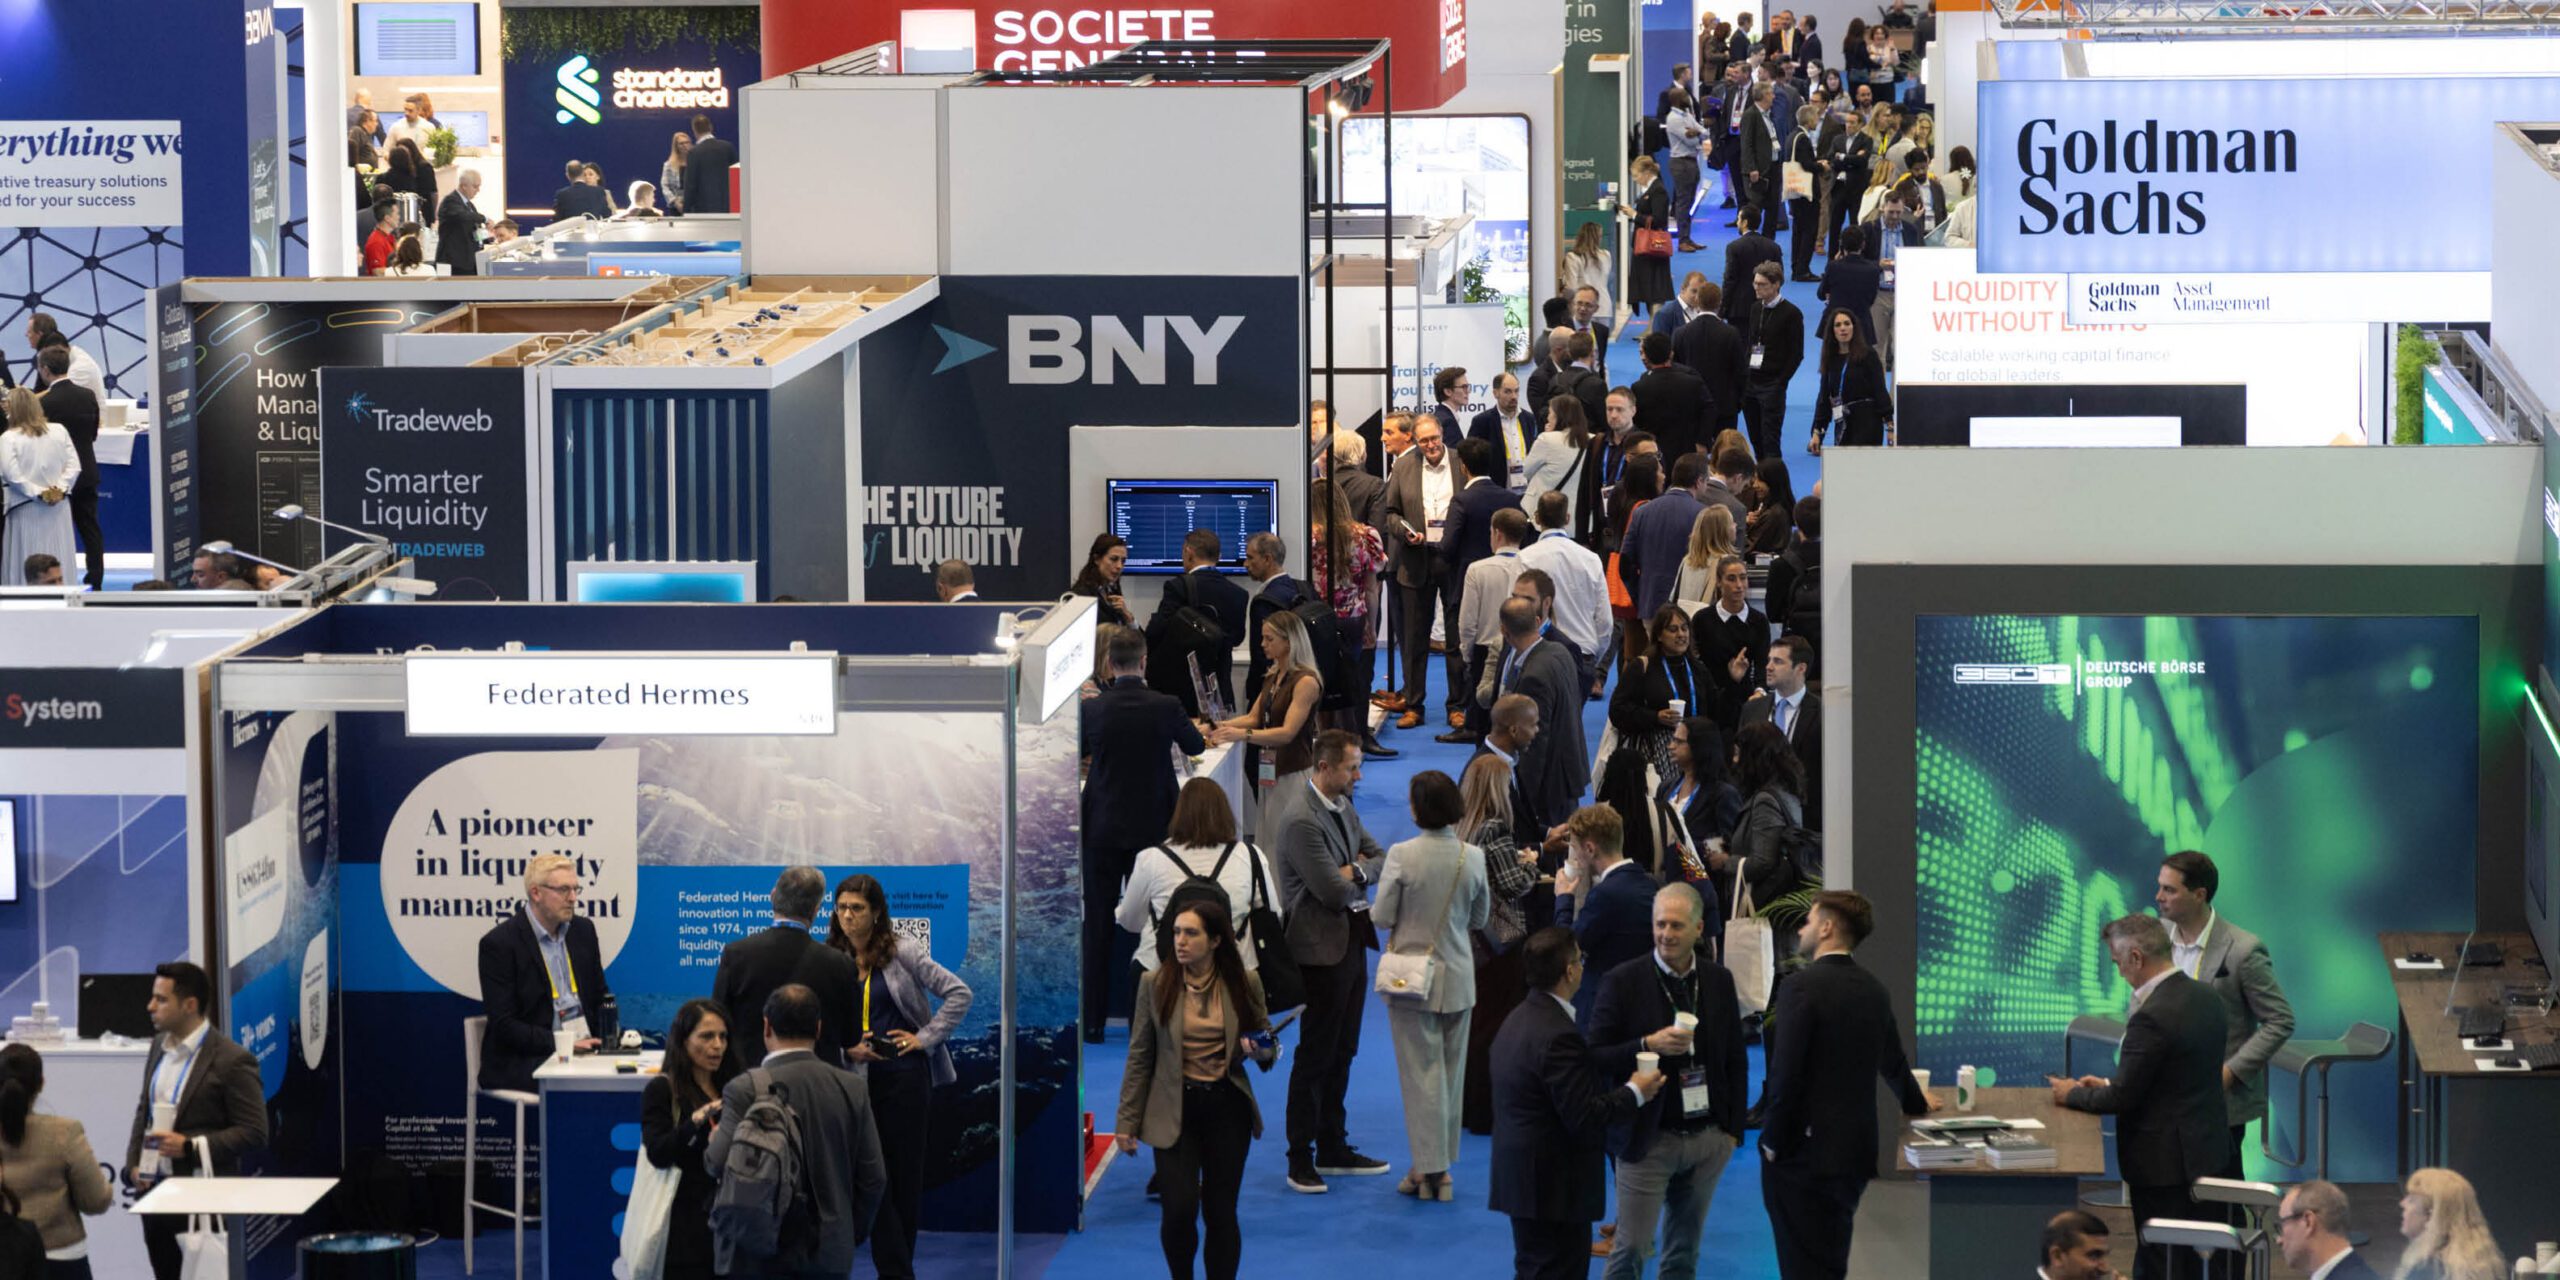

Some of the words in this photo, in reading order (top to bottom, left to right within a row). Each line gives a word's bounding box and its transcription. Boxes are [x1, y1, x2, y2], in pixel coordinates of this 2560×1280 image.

[245, 7, 274, 45] BBVA
[994, 10, 1215, 44] SOCIETE
[613, 67, 702, 88] standard
[613, 87, 728, 108] chartered
[2017, 118, 2298, 180] Goldman
[34, 175, 96, 191] treasury
[100, 174, 168, 188] solutions
[16, 194, 36, 206] for
[40, 196, 73, 209] your
[77, 196, 136, 206] success
[2018, 180, 2207, 236] Sachs
[1933, 281, 2058, 304] LIQUIDITY
[2088, 282, 2160, 299] Goldman
[2174, 281, 2213, 296] Asset
[2088, 297, 2137, 312] Sachs
[2173, 297, 2271, 313] Management
[1932, 311, 2053, 332] WITHOUT
[1008, 315, 1246, 385] BNY
[1931, 348, 1994, 363] Scalable
[1999, 349, 2057, 366] working
[2062, 348, 2112, 366] capital
[2115, 348, 2170, 362] finance
[257, 369, 306, 388] How
[1931, 368, 1952, 382] for
[1956, 368, 2000, 383] global
[372, 408, 493, 432] Tradeweb
[258, 421, 274, 441] &
[365, 467, 483, 494] Smarter
[362, 498, 488, 531] Liquidity
[901, 486, 1005, 526] FUTURE
[891, 527, 1023, 574] LIQUIDITY
[2085, 662, 2156, 674] DEUTSCHE
[2160, 659, 2206, 674] BÖRSE
[2085, 676, 2133, 688] GROUP
[488, 682, 631, 705] Federated
[641, 684, 750, 706] Hermes
[6, 694, 102, 727] System
[425, 808, 447, 836] A
[459, 808, 594, 845] pioneer
[416, 849, 448, 876] in
[679, 892, 739, 903] Federated
[679, 908, 739, 918] innovation
[742, 908, 752, 918] in
[679, 924, 708, 935] since
[712, 924, 744, 936] 1974,
[679, 940, 726, 953] liquidity
[680, 956, 692, 966] all
[385, 1125, 411, 1133] Capital
